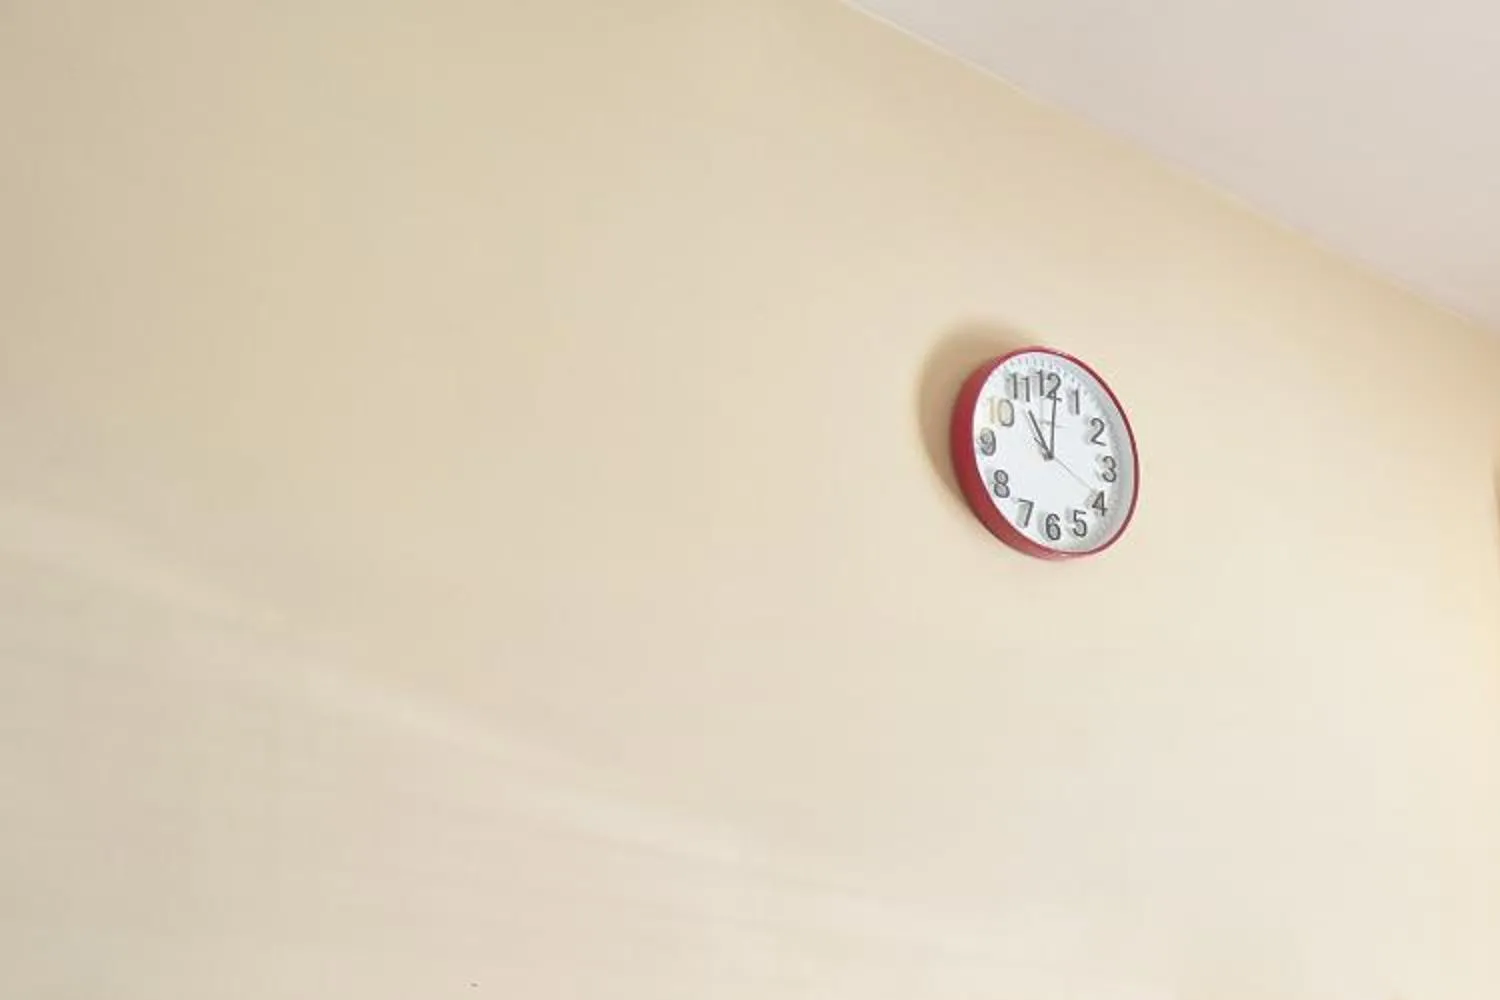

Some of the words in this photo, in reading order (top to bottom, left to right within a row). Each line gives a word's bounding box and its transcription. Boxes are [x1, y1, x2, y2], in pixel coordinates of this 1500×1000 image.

[1011, 373, 1030, 402] 11
[1038, 370, 1061, 402] 12
[989, 399, 1014, 427] 10
[980, 429, 996, 456] 9
[1091, 418, 1106, 445] 2
[1102, 456, 1117, 482] 3
[994, 470, 1010, 498] 8
[1018, 499, 1034, 528] 7
[1092, 491, 1107, 516] 4
[1046, 514, 1060, 540] 6
[1073, 510, 1087, 537] 5
